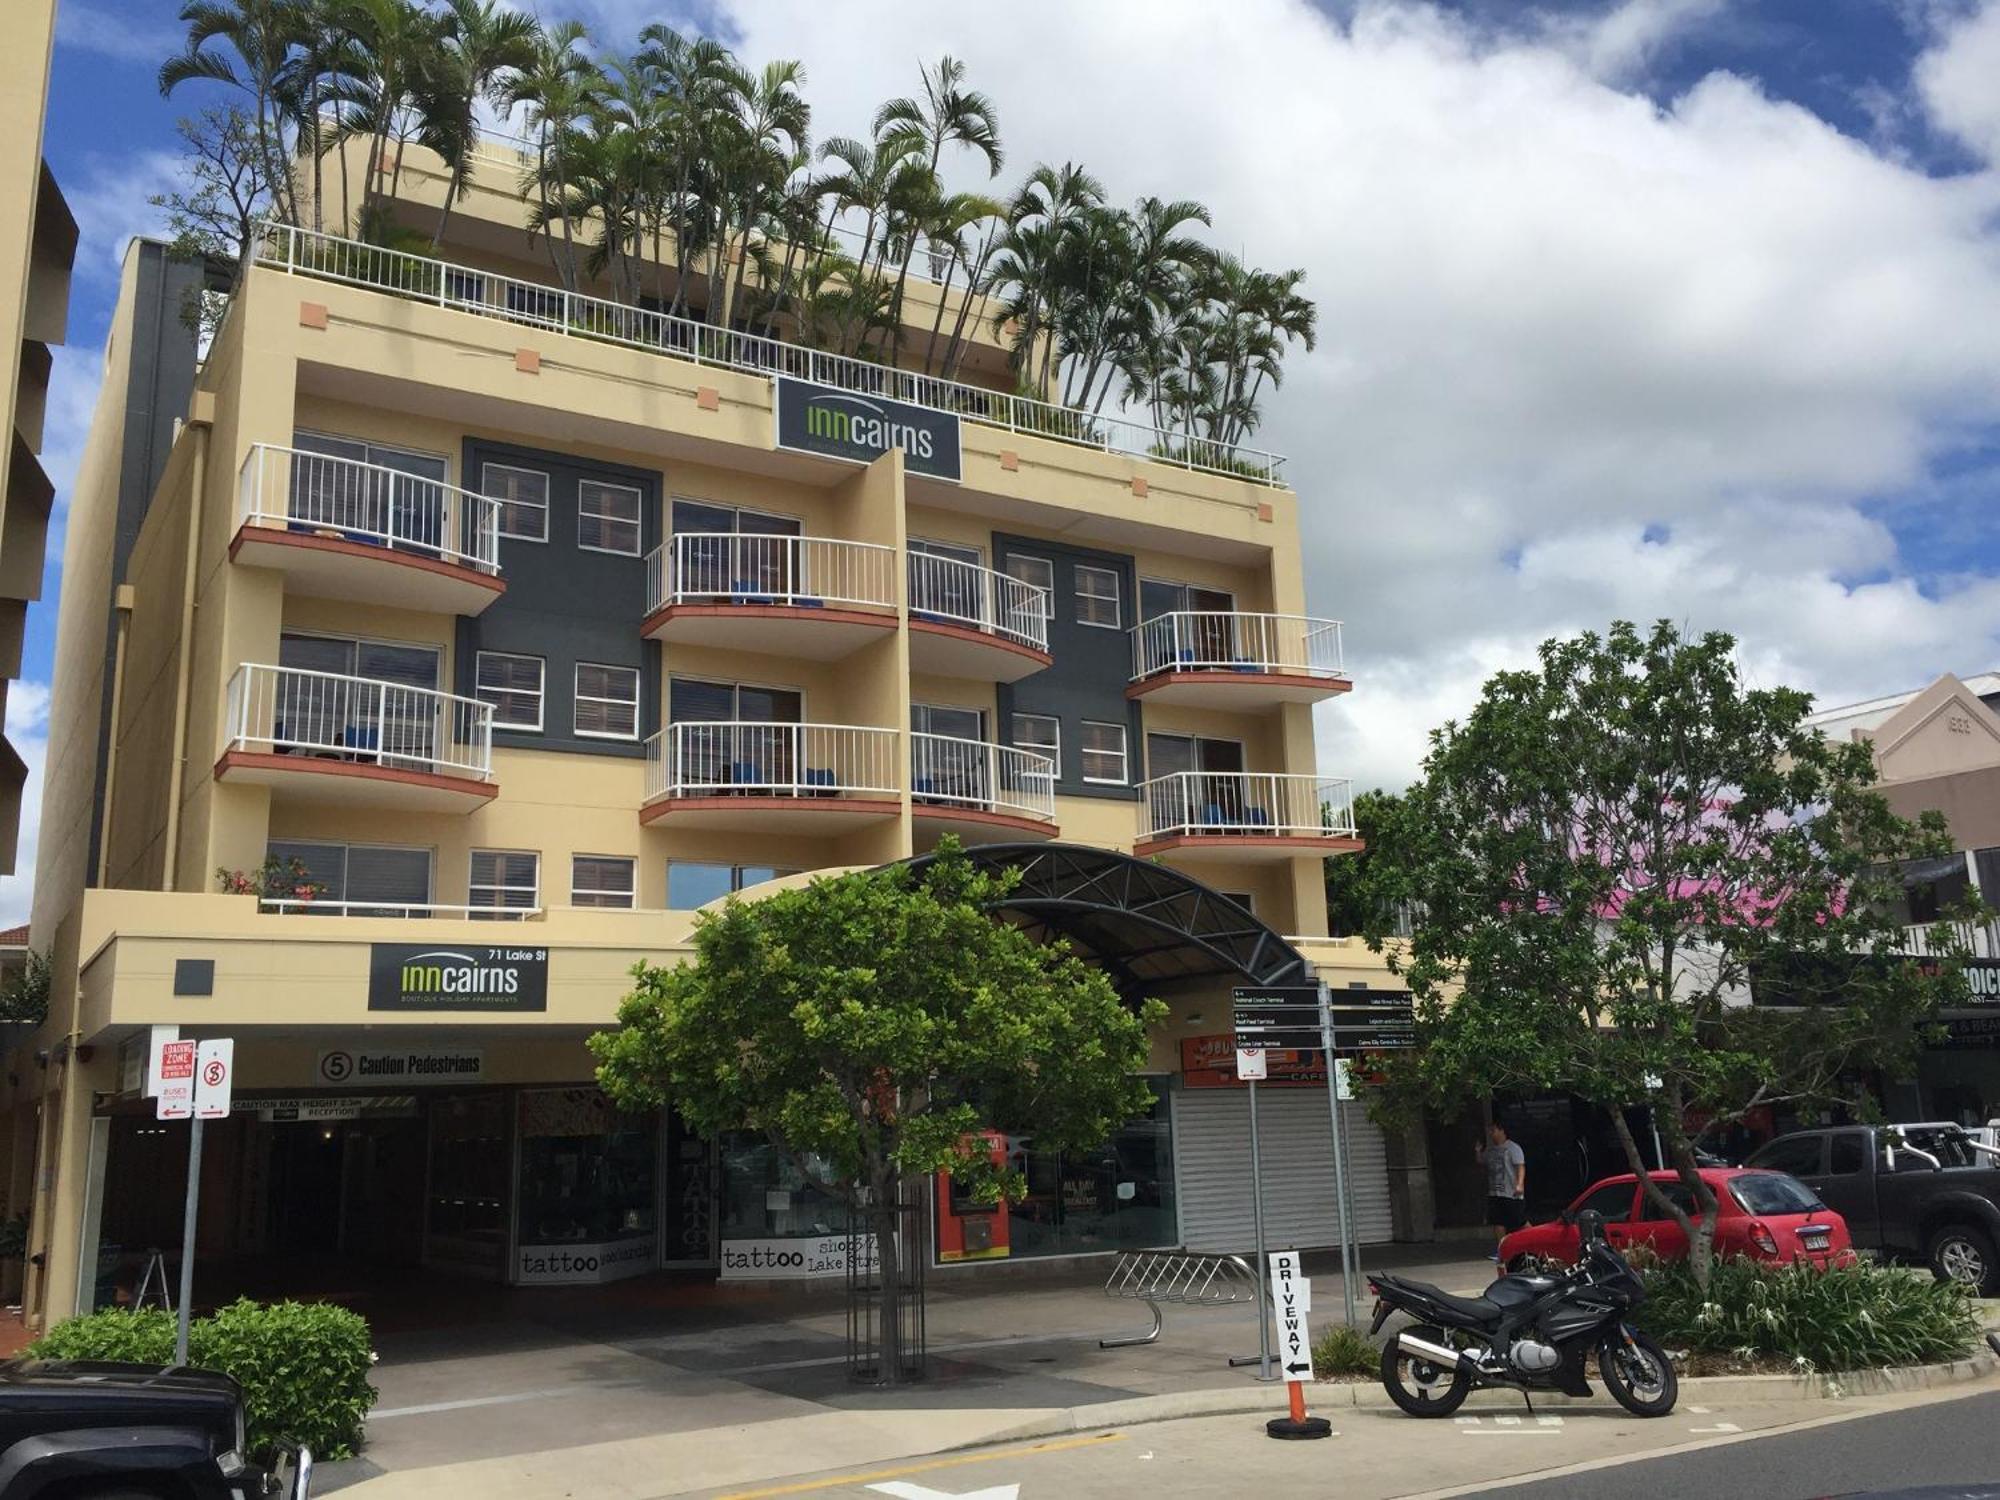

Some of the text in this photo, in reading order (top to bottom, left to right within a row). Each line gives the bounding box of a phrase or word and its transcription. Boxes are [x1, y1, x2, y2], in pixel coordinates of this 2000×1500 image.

[807, 405, 933, 459] inncairns
[488, 949, 546, 961] 71 Lake St
[402, 960, 519, 993] inncairns
[164, 1043, 193, 1055] LOADING
[166, 1053, 189, 1064] ZONE
[329, 1054, 480, 1076] 5 Caution Pedestrians
[232, 1100, 277, 1109] CAUTION
[308, 1107, 354, 1117] RECEPTION
[521, 1251, 599, 1273] tattoo
[724, 1246, 804, 1268] tattoo
[807, 1256, 843, 1273] Lake
[1279, 1257, 1301, 1356] DRIVEWAY
